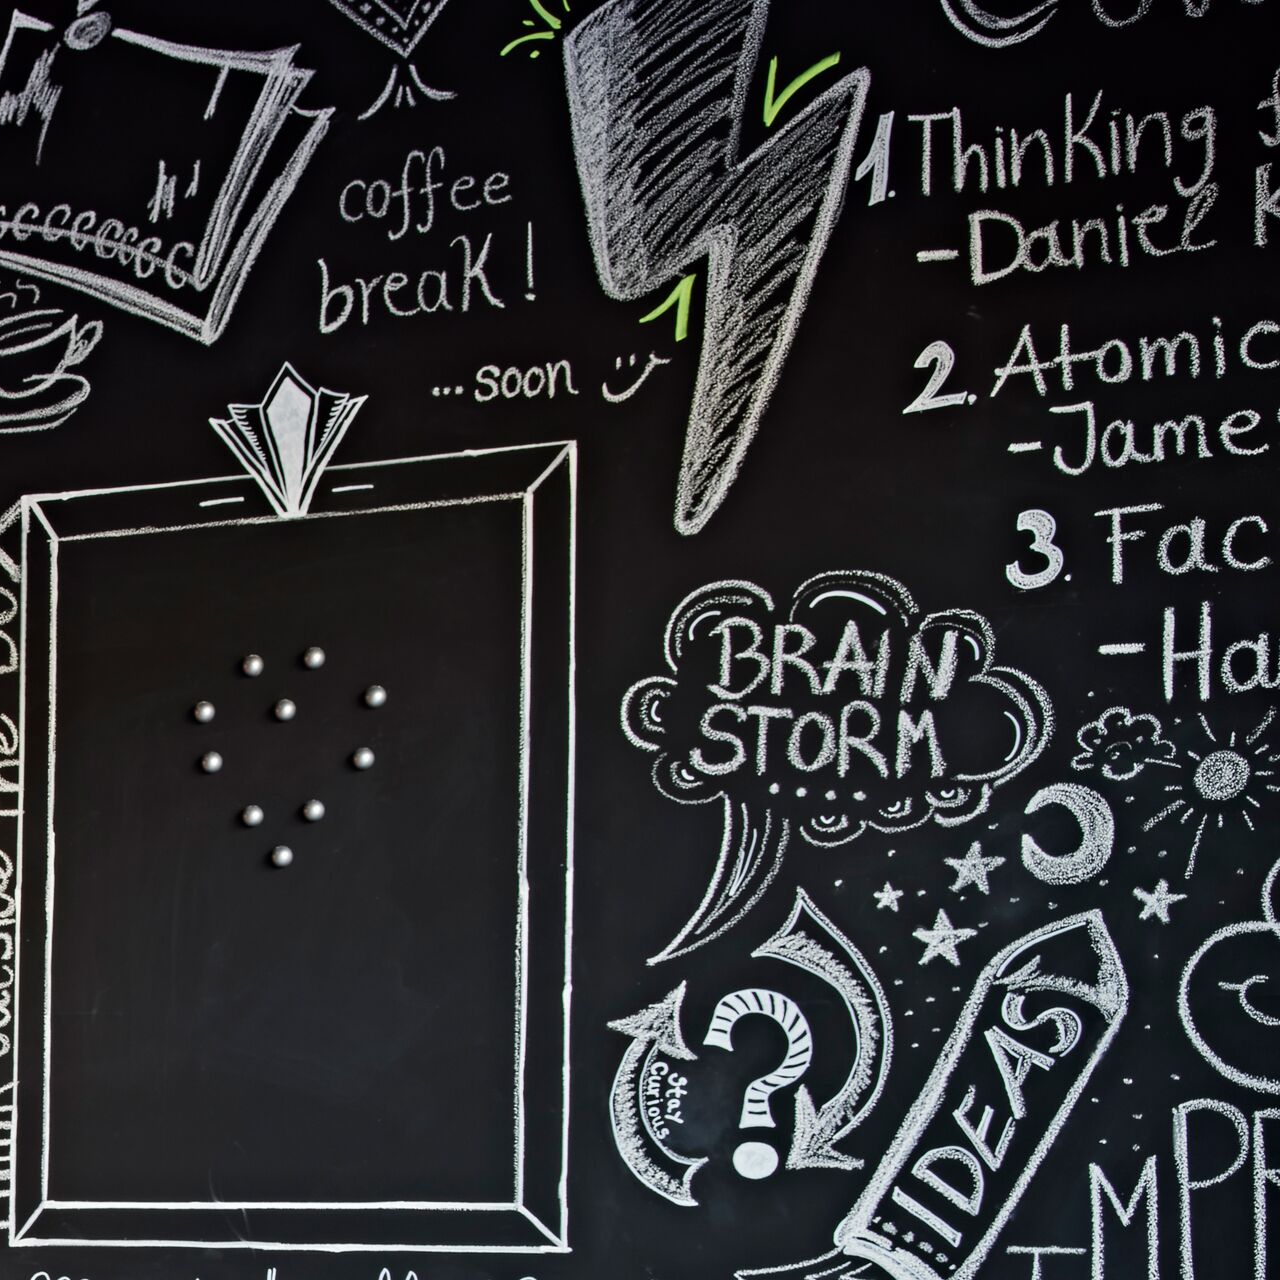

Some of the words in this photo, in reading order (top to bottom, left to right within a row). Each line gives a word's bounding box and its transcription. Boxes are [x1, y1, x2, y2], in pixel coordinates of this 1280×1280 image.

[338, 147, 513, 242] coffee
[705, 616, 960, 703] BRAIN
[688, 700, 948, 778] STORM
[646, 1061, 670, 1140] Curious
[664, 1072, 689, 1124] Stay
[891, 989, 1084, 1248] IDEAS
